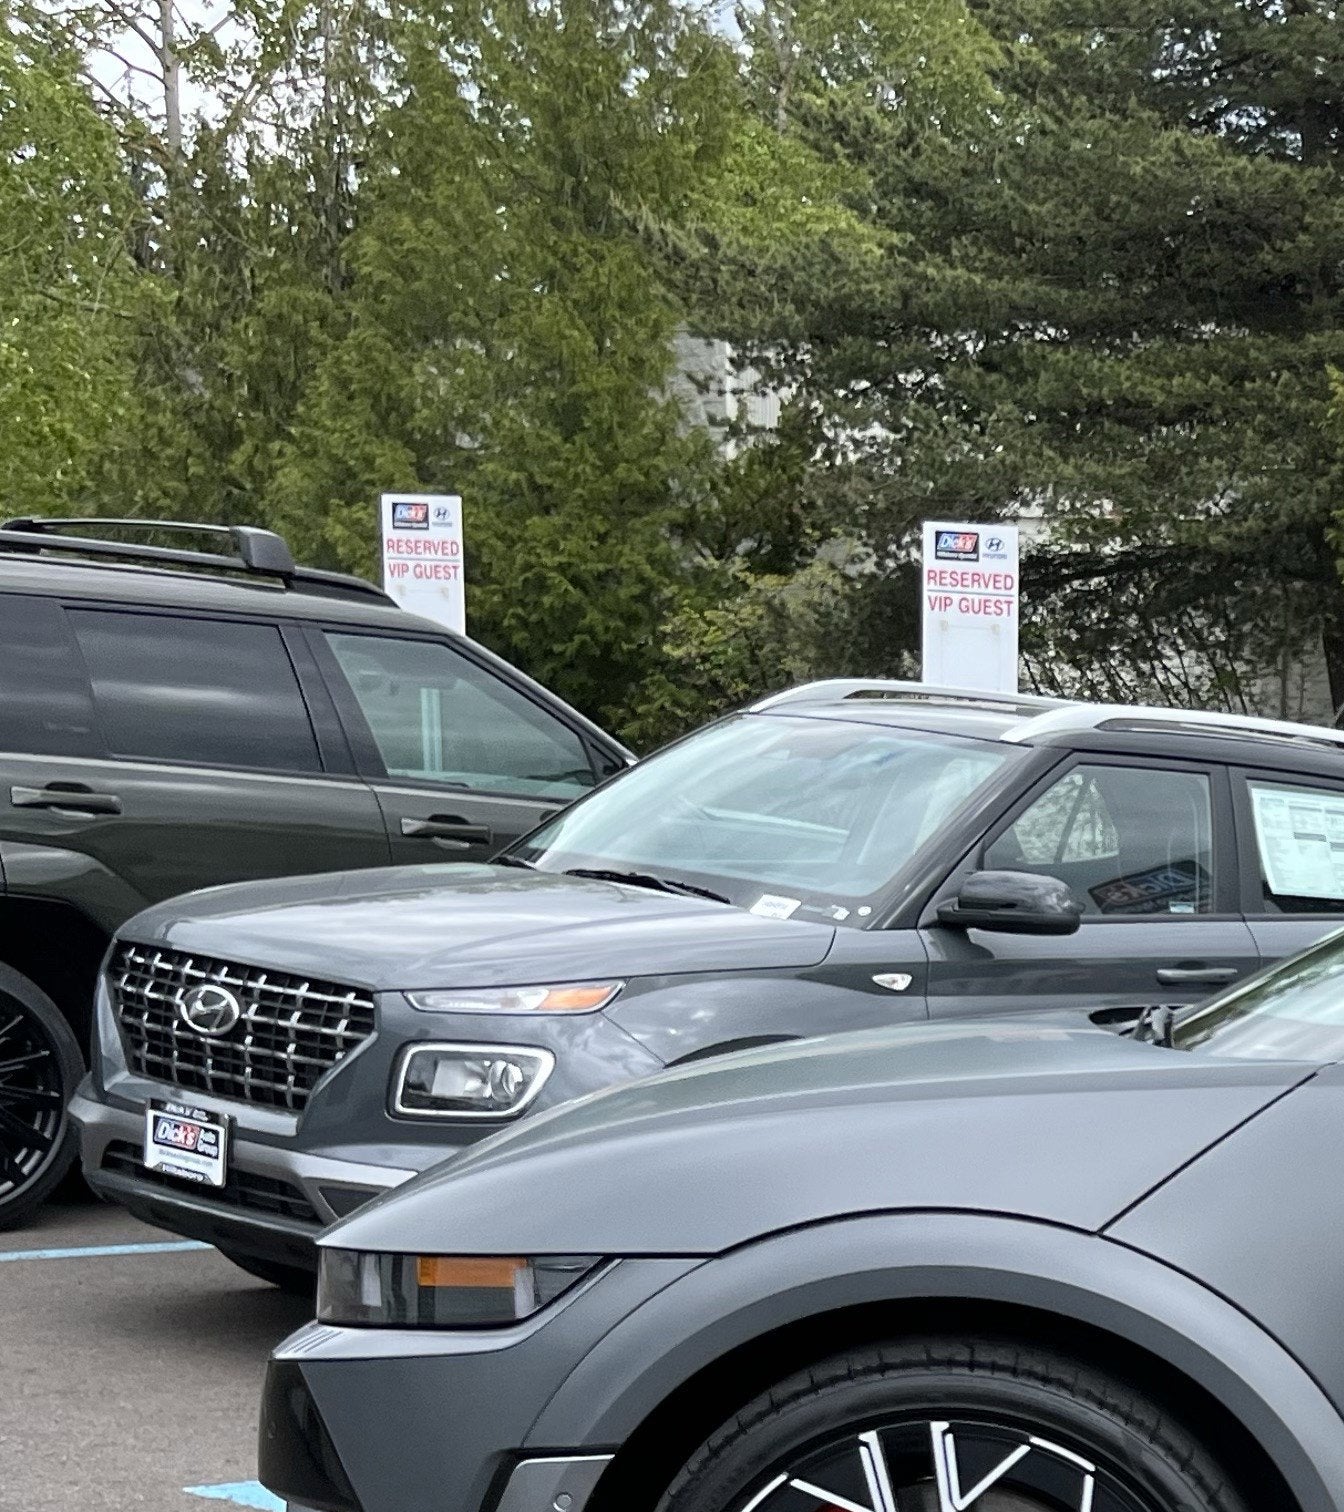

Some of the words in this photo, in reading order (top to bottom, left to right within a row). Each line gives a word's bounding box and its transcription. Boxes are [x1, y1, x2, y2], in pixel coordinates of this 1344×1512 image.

[387, 539, 460, 556] RESERVED
[388, 563, 409, 579] VIP
[413, 564, 460, 580] GUEST
[927, 570, 1014, 590] RESERVED
[928, 595, 953, 611] VIP
[958, 597, 1014, 617] GUEST
